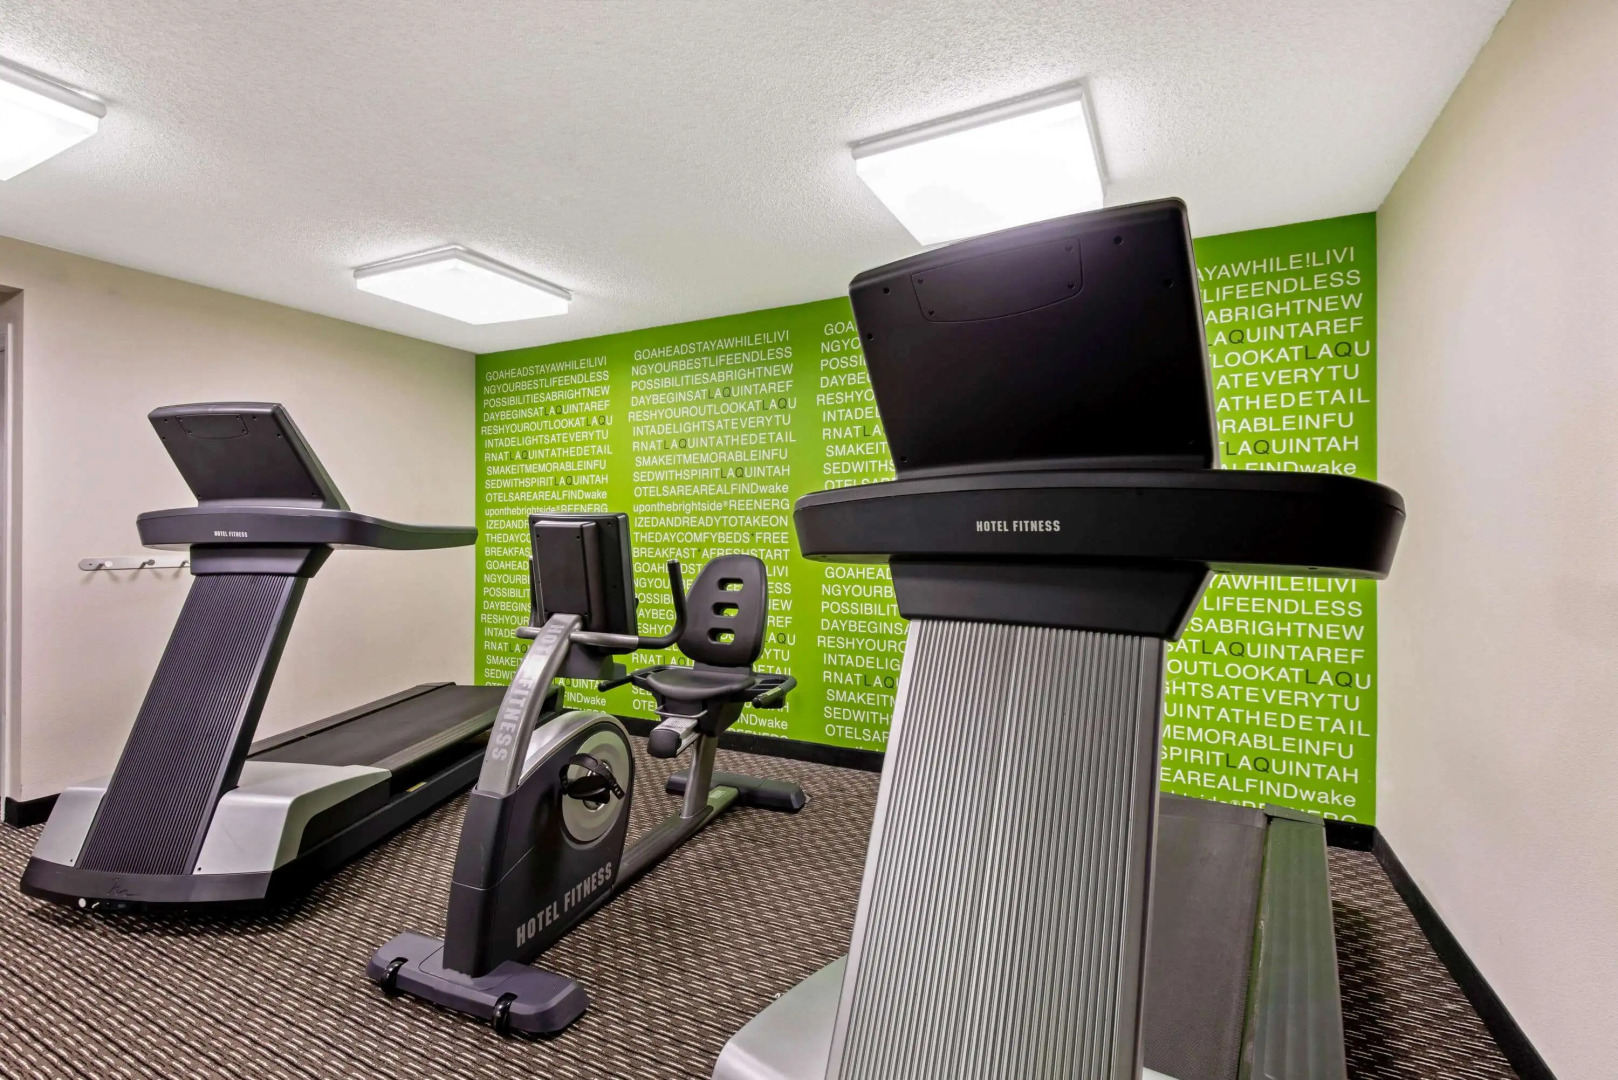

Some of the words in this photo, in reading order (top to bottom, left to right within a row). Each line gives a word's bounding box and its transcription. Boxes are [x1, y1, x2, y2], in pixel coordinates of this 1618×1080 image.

[1201, 270, 1361, 304] LIFEENDLESS
[824, 320, 858, 336] GOA
[1208, 316, 1364, 346] AQUINTAREF
[634, 330, 789, 360] GOAHEADSTAYAWHILE!LIVI
[1210, 340, 1370, 368] LOOKATLAQU
[486, 356, 606, 381] GOAHEADSTAYAWHILE!LIVI
[631, 346, 792, 376] NGYOURBESTLIFEENDLESS
[484, 370, 609, 395] NGYOURBESTLIFEENDLESS
[631, 363, 793, 391] POSSIBILITIESABRIGHTNEW
[1216, 364, 1360, 390] ATEVERYTU
[483, 386, 610, 408] POSSIBILITIESABRIGHTNEW
[631, 380, 794, 407] DAYBEGINSATLAQUINTAREF
[1217, 388, 1370, 413] ATHEDETAIL
[484, 400, 610, 422] DAYBEGINSATLAQUINTAREF
[628, 397, 797, 422] RESHYOUROUTLOOKATLAQU
[481, 415, 612, 435] RESHYOUROUTLOOKATLAQU
[633, 414, 791, 436] INTADELIGHTSATEVERYTU
[1217, 412, 1354, 434] RABLEINFU
[485, 430, 608, 448] INTADELIGHTSATEVERYTU
[633, 431, 797, 452] RNATLAQUINTATHEDETAIL
[484, 445, 612, 462] RNATLAQUINTATHEDETAIL
[635, 448, 788, 467] SMAKEITMEMORABLEINFU
[486, 460, 606, 475] SMAKEITMEMORABLEINFU
[633, 465, 790, 482] SEDWITHSPIRITLAQUINTAH
[485, 474, 608, 489] SEDWITHSPIRITLAQUINTAH
[634, 482, 789, 498] OTELSAREAREALFINDwake
[486, 490, 607, 502] OTELSAREAREALFINDwake
[635, 515, 788, 527] IZEDANDREADYTOTAKEON
[976, 520, 1009, 532] HOTEL
[1012, 520, 1060, 532] FITNESS
[822, 584, 896, 598] NGYOURB
[1203, 596, 1363, 617] LIFEENDLESS
[1185, 617, 1364, 641] SABRIGHTNEW
[484, 640, 531, 653] RNATLAQ
[823, 671, 899, 689] RNATLAQ
[824, 706, 892, 725] SEDWITH
[516, 901, 559, 948] HOTEL
[564, 861, 612, 913] FITNESS
